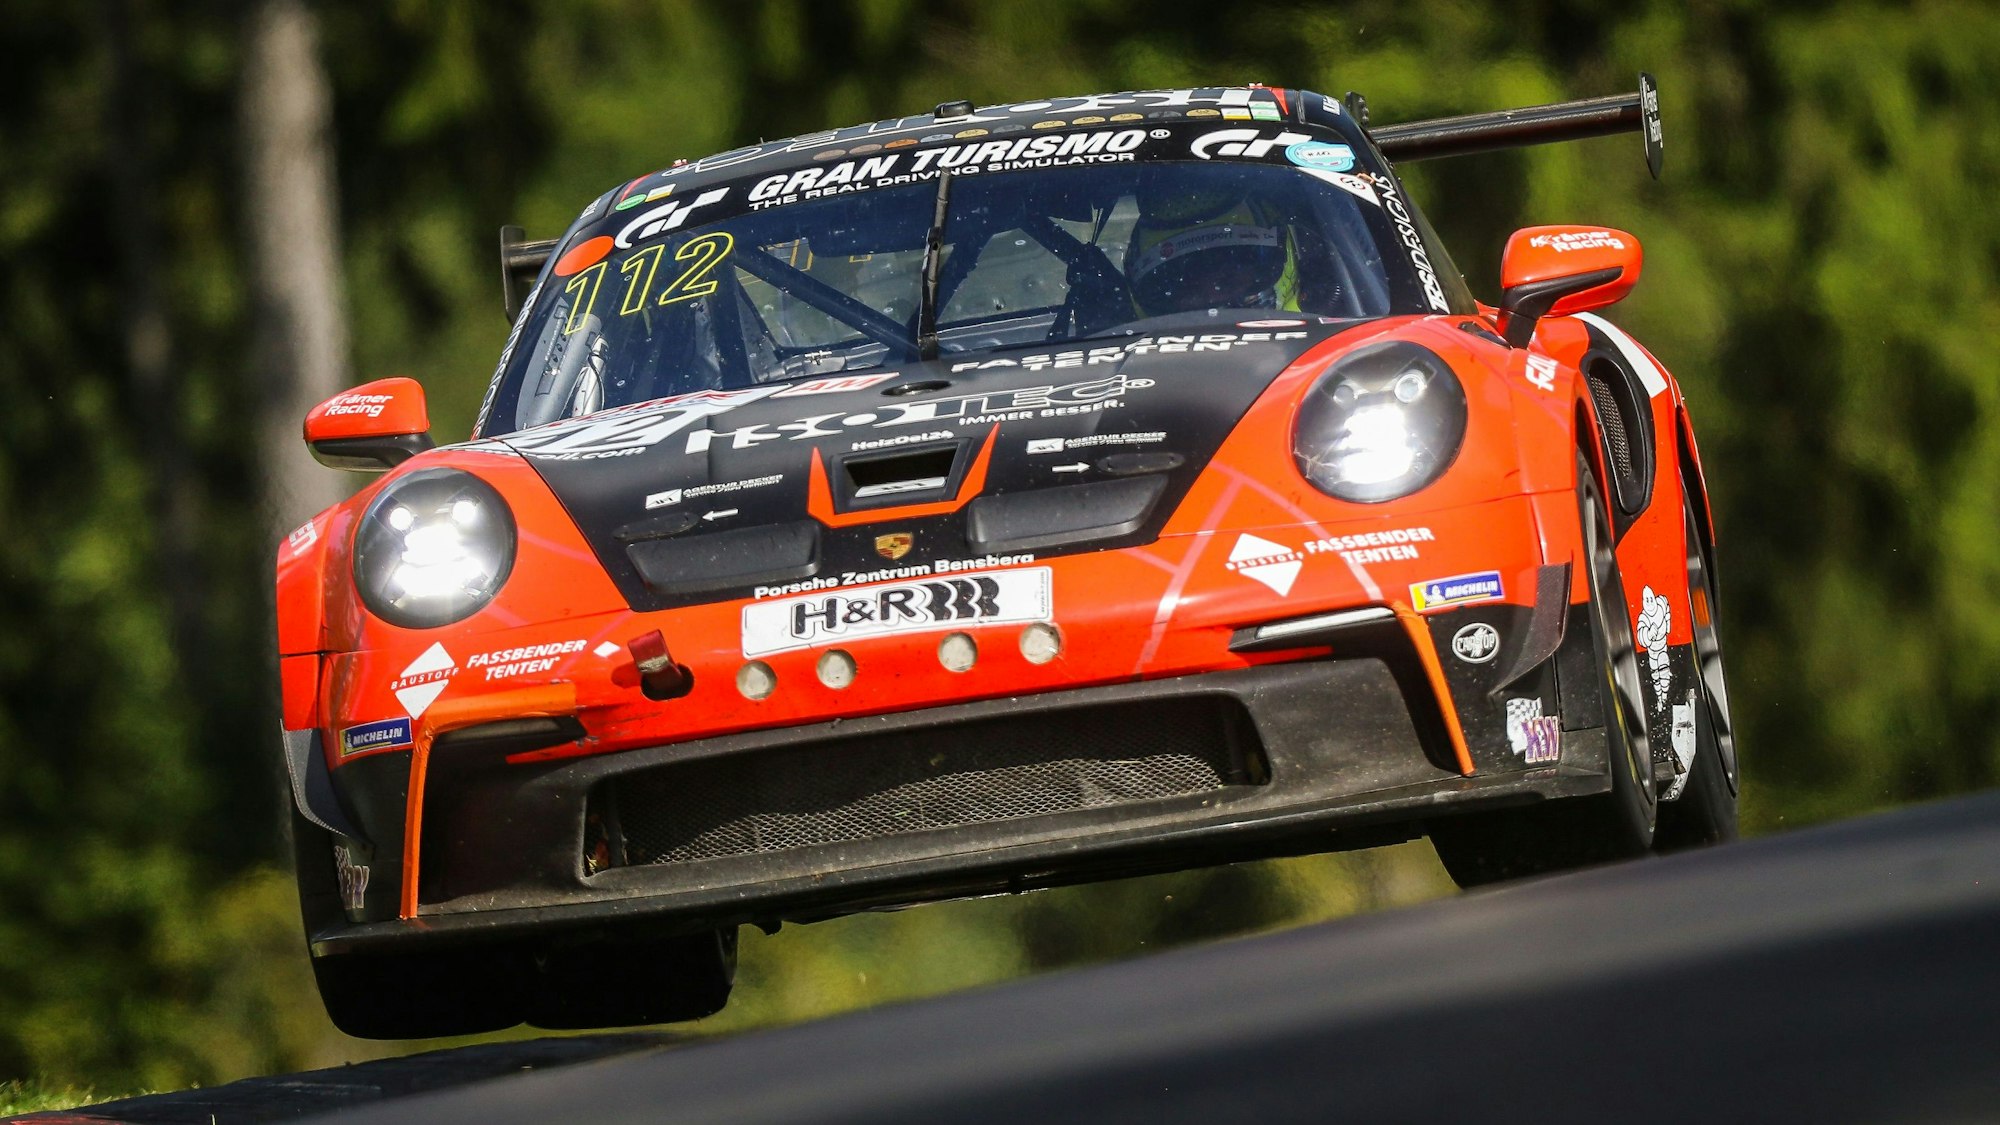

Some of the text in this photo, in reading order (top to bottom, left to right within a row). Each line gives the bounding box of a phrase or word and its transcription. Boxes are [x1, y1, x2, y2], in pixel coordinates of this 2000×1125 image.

[748, 154, 900, 202] GRAN
[748, 151, 1135, 212] THE REAL DRIVING SIMULATOR
[1552, 237, 1625, 253] Racing
[564, 231, 735, 336] 112
[324, 401, 385, 418] Racing
[325, 393, 394, 408] Krämer
[958, 409, 1034, 426] IMMER
[1303, 526, 1435, 554] FASSBENDER
[1340, 544, 1420, 565] TENTEN
[754, 552, 1035, 600] Porsche Zentrum Bensberg
[1444, 580, 1498, 599] MICHELIN
[466, 639, 588, 669] FASSBENDER
[390, 666, 461, 691] BAUSTOFF
[352, 727, 404, 746] MICHELIN
